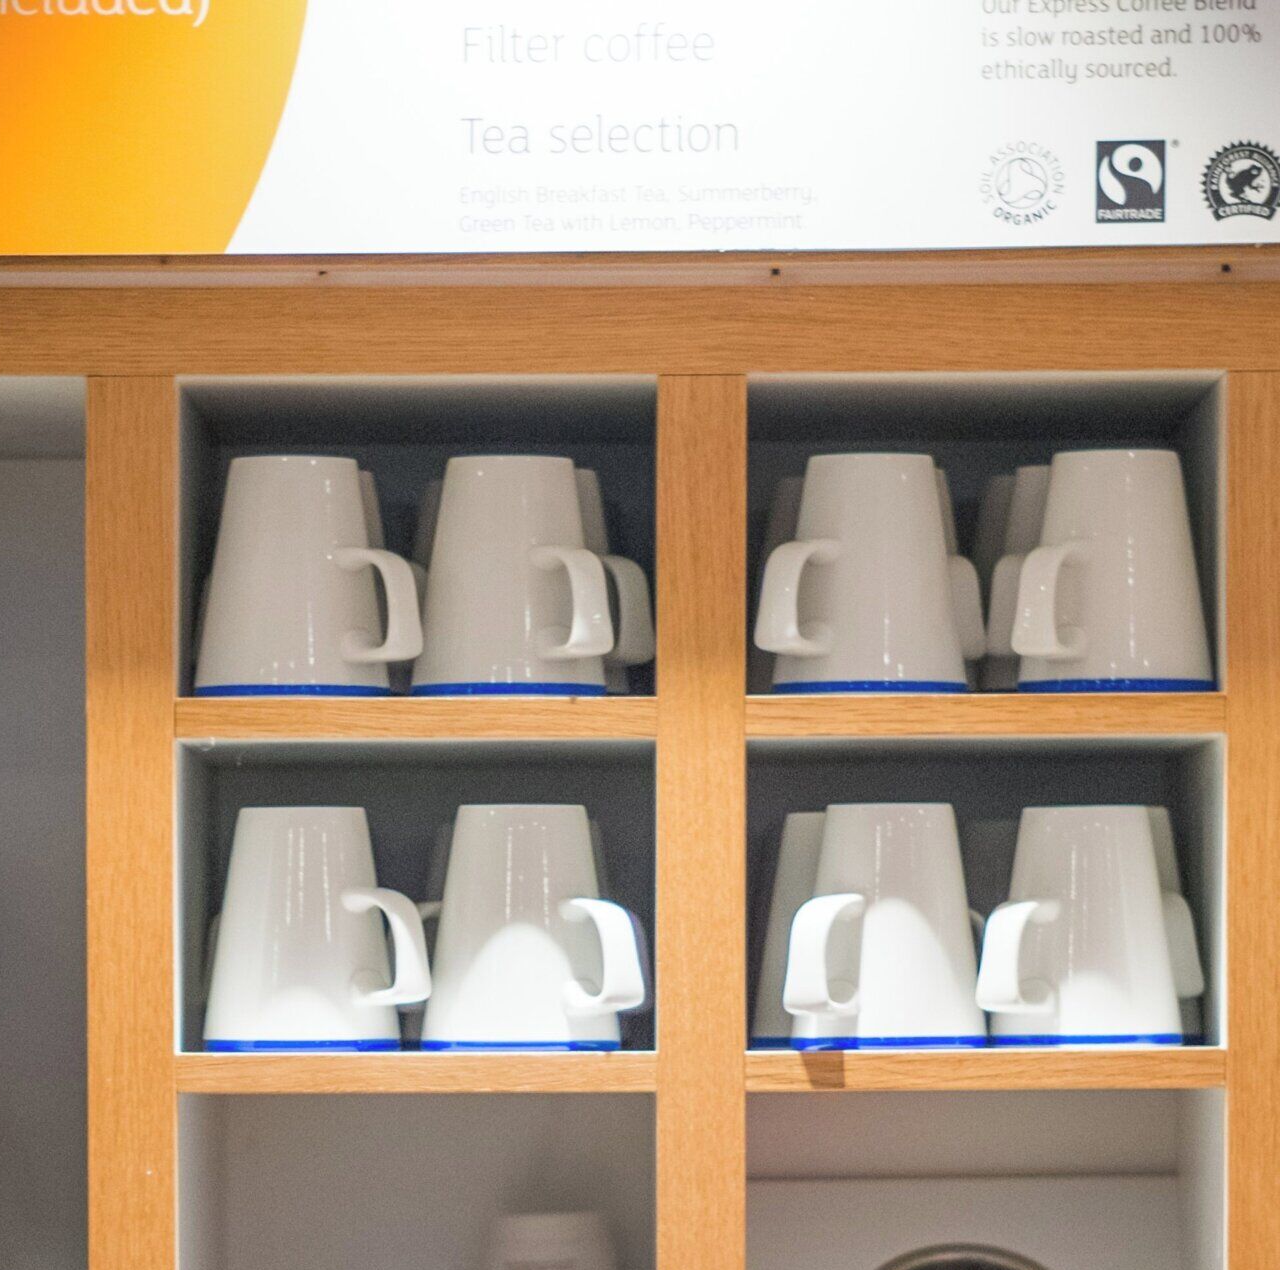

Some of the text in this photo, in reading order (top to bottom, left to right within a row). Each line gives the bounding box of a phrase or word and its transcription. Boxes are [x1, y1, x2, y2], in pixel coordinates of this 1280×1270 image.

[464, 22, 715, 63] Filter coffee
[981, 23, 1262, 47] is slow roasted and 100%
[981, 57, 1178, 84] ethically sourced.
[460, 114, 740, 154] Tea selection
[458, 185, 528, 208] English
[536, 184, 627, 205] Breakfast
[458, 215, 516, 233] Green
[523, 214, 554, 232] Tea
[560, 213, 603, 232] with
[992, 199, 1058, 226] ORGANIC
[1096, 208, 1163, 221] FAIRTRADE
